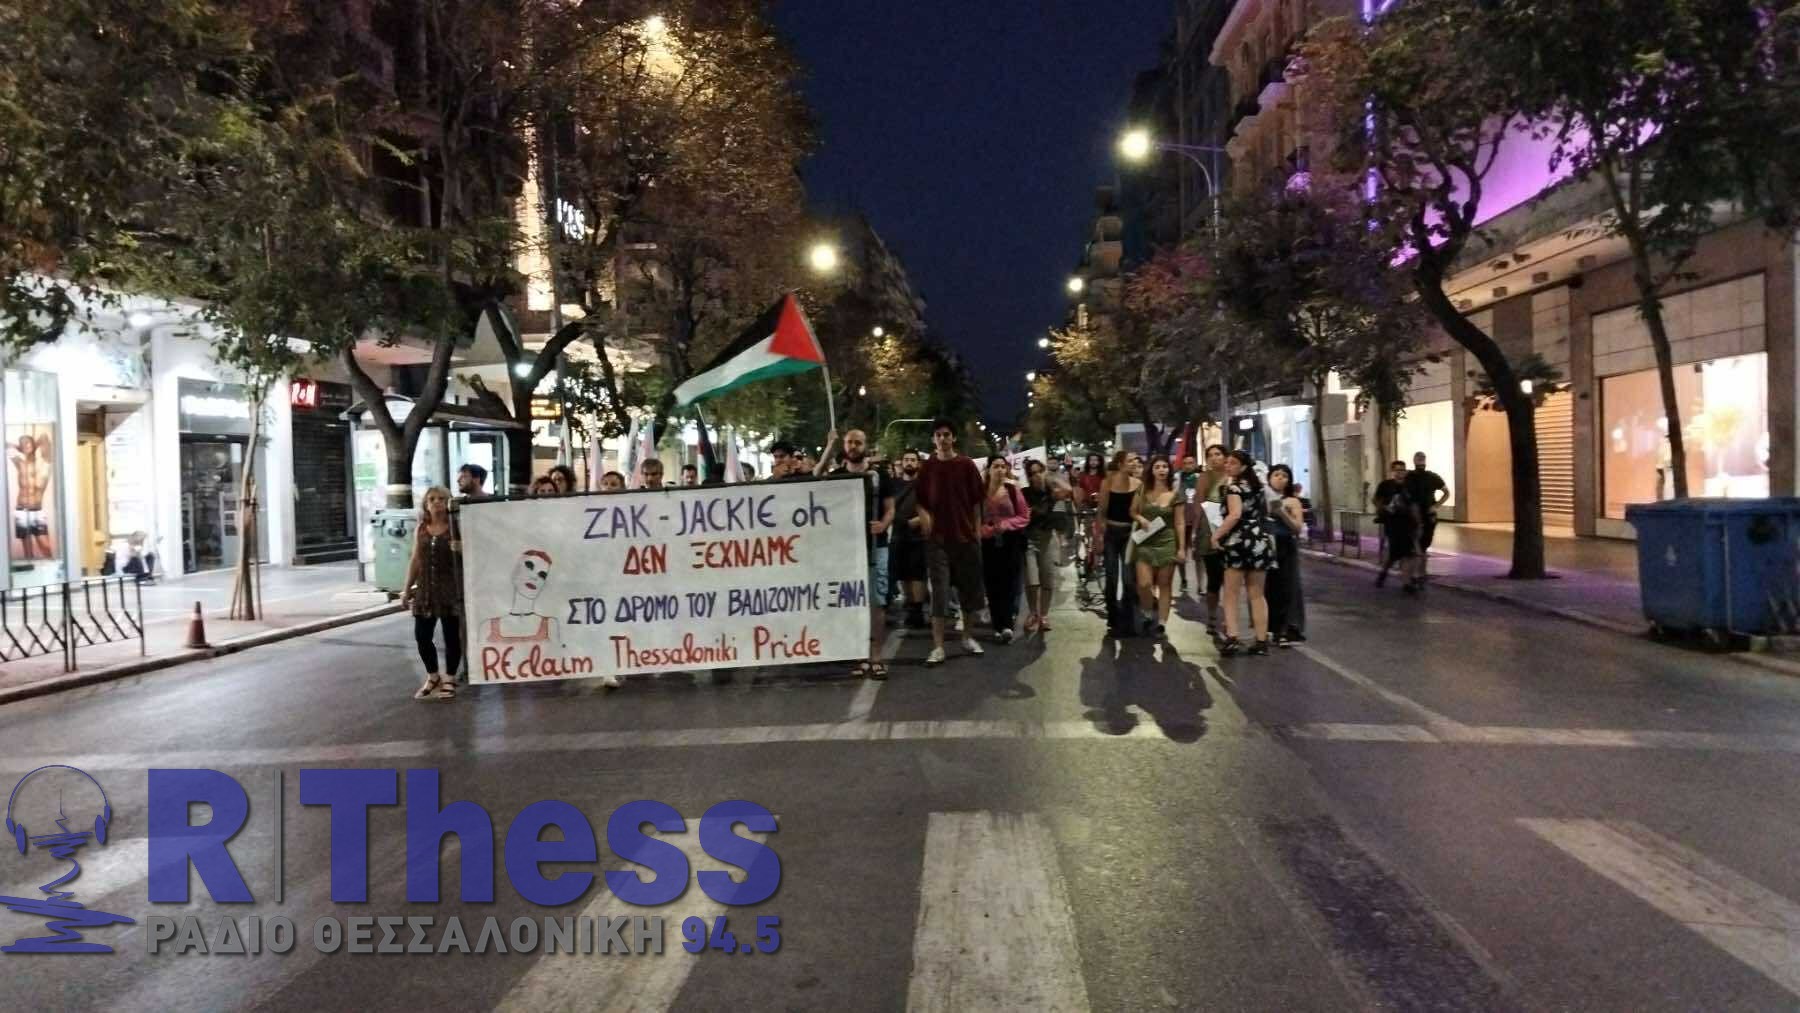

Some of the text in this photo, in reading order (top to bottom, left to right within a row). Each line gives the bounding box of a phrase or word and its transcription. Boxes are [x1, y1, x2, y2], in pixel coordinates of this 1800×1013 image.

[792, 492, 830, 528] oh
[623, 534, 800, 575] ΔΕΝ ΞΕΧΝΑΜΕ
[567, 580, 866, 625] ΣΤΟ ΔΡΟΜΟ ΤΟΥ ΒΑΔΙΖΟΥΜΕ ΞΑΝΑ
[610, 633, 738, 668] Thessaloniki
[753, 626, 821, 658] Pride
